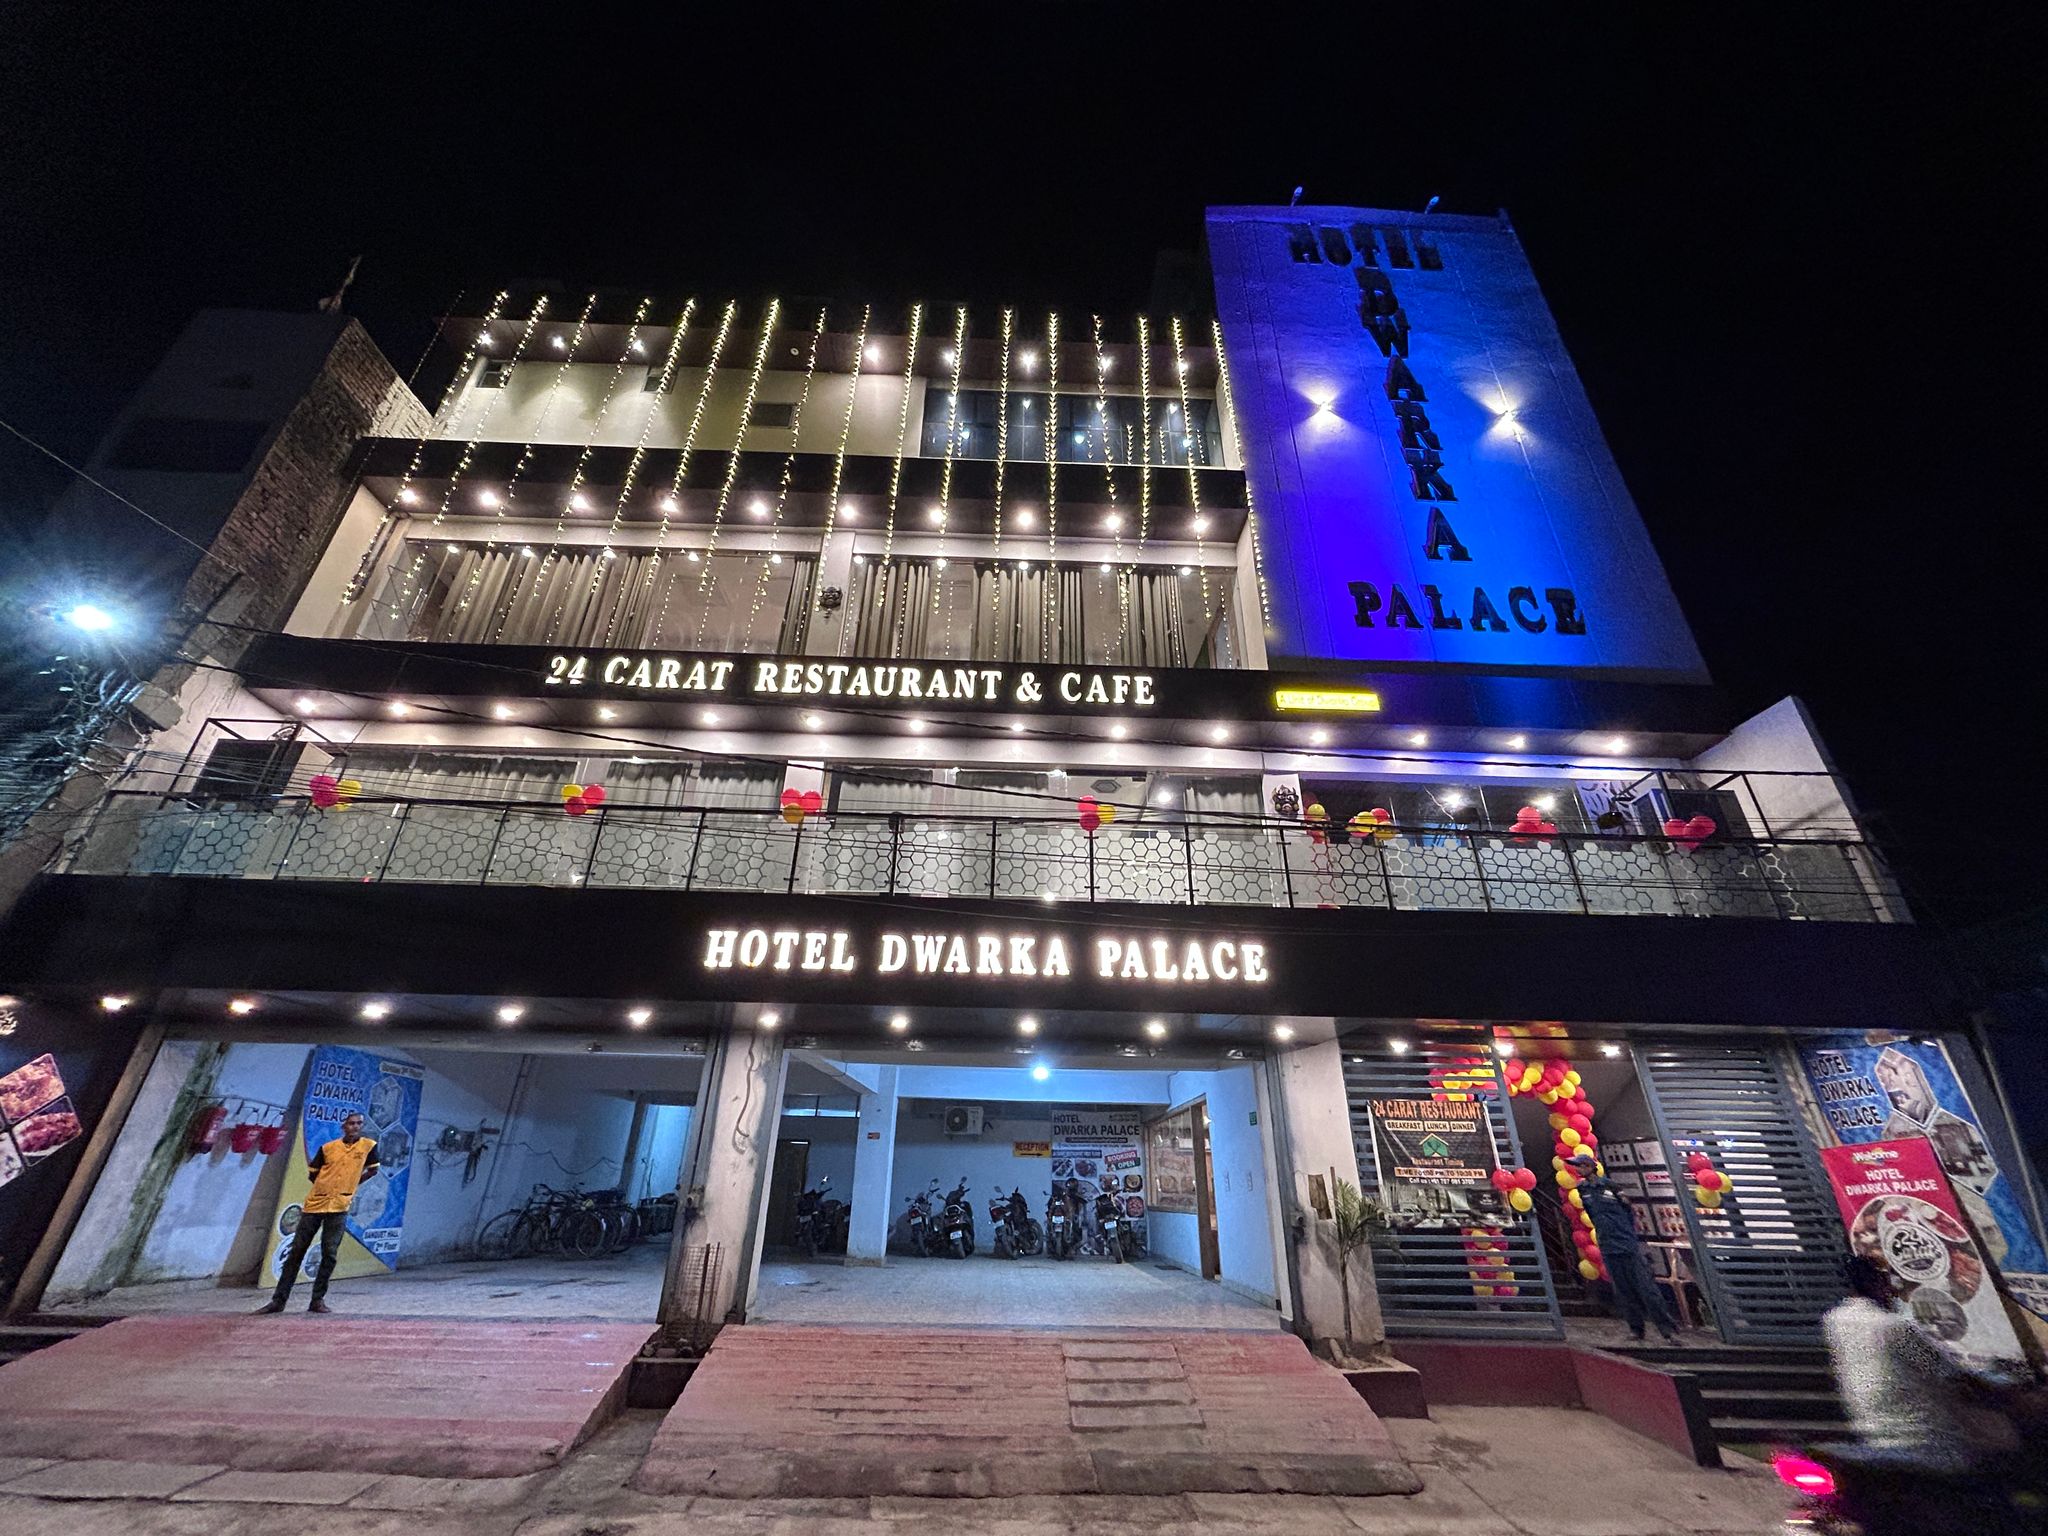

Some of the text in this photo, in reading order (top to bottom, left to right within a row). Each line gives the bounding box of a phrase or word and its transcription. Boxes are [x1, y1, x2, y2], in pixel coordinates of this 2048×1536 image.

[1348, 581, 1587, 635] PALACE
[545, 656, 1156, 705] 24 CARAT RESTAURANT & CAFE
[703, 929, 1269, 982] HOTEL DWARKA PALACE
[319, 1061, 356, 1082] HOTEL
[1811, 1055, 1853, 1078] HOTEL
[313, 1081, 363, 1103] DWARKA
[1819, 1077, 1877, 1102] DWARKA
[1054, 1114, 1080, 1123] HOTEL
[1386, 1101, 1417, 1118] CARAT
[1420, 1102, 1482, 1119] RESTAURANT
[1830, 1105, 1883, 1128] PALACE
[1054, 1125, 1140, 1136] DWARKA PALACE
[1387, 1121, 1421, 1130] BREAKFAST
[1427, 1122, 1448, 1130] LUNCH
[1451, 1122, 1475, 1131] DINNER
[1865, 1169, 1904, 1181] HOTEL
[1845, 1180, 1940, 1196] DWARKA PALACE
